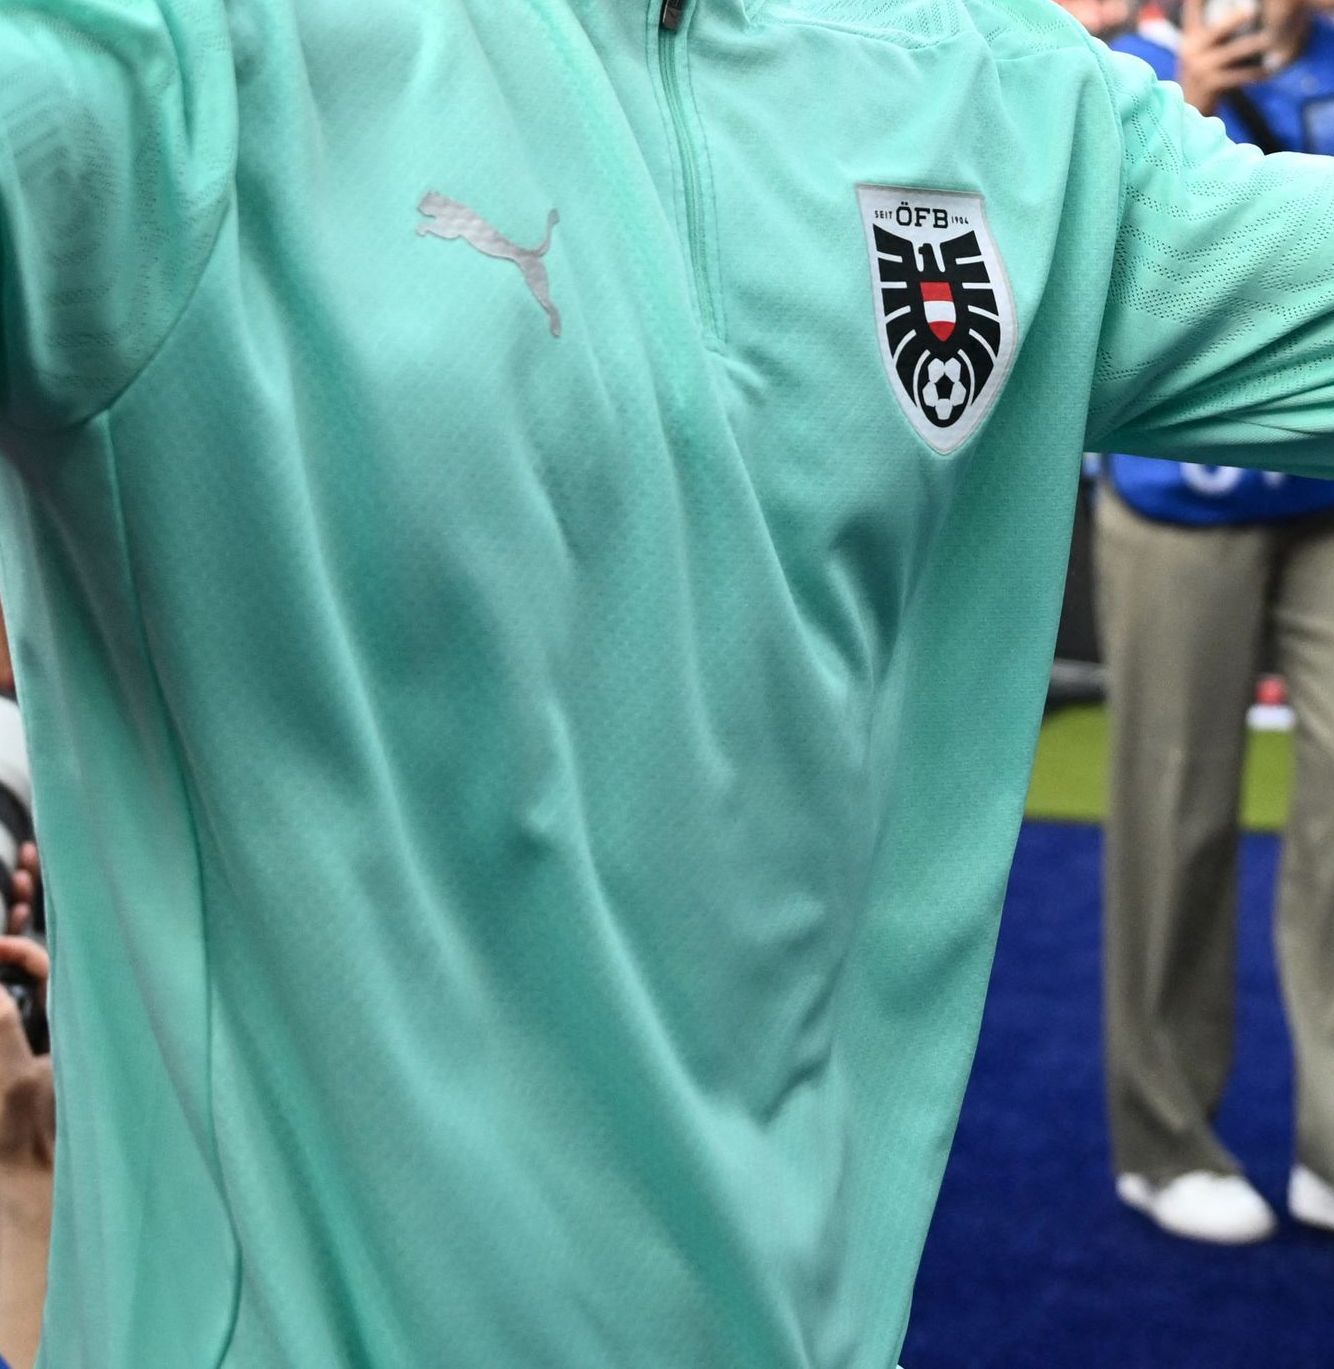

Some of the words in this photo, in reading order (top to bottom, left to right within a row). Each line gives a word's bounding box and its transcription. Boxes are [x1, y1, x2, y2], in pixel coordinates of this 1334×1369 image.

[874, 210, 892, 219] SEIT
[896, 201, 949, 229] ÖFB
[951, 215, 969, 224] 1904
